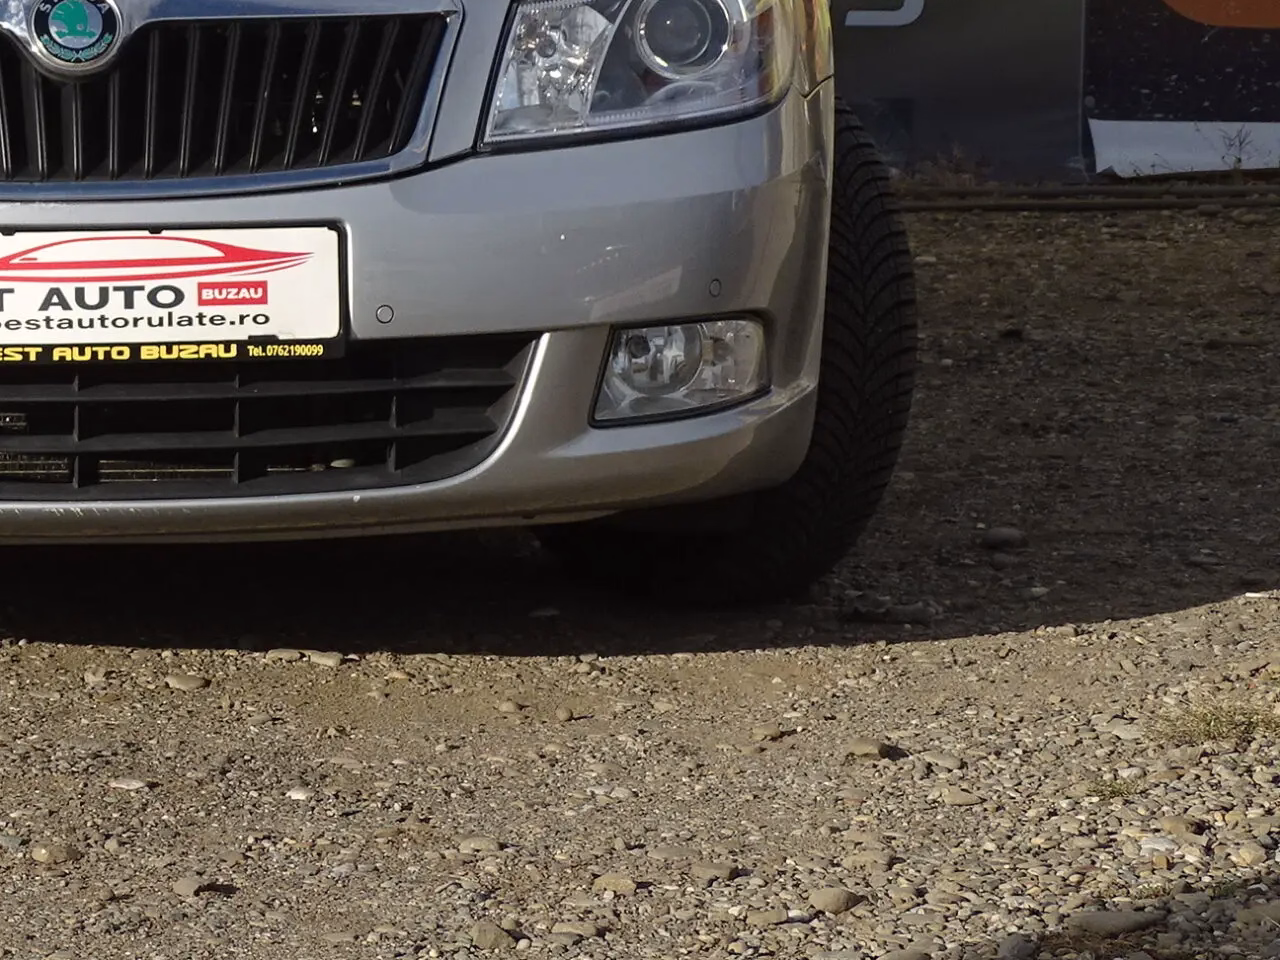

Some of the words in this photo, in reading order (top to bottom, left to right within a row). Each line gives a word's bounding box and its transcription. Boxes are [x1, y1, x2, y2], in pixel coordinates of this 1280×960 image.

[38, 284, 186, 312] AUTO
[201, 287, 264, 301] BUZAU
[52, 345, 131, 361] AUTO
[140, 343, 238, 360] BUZAU
